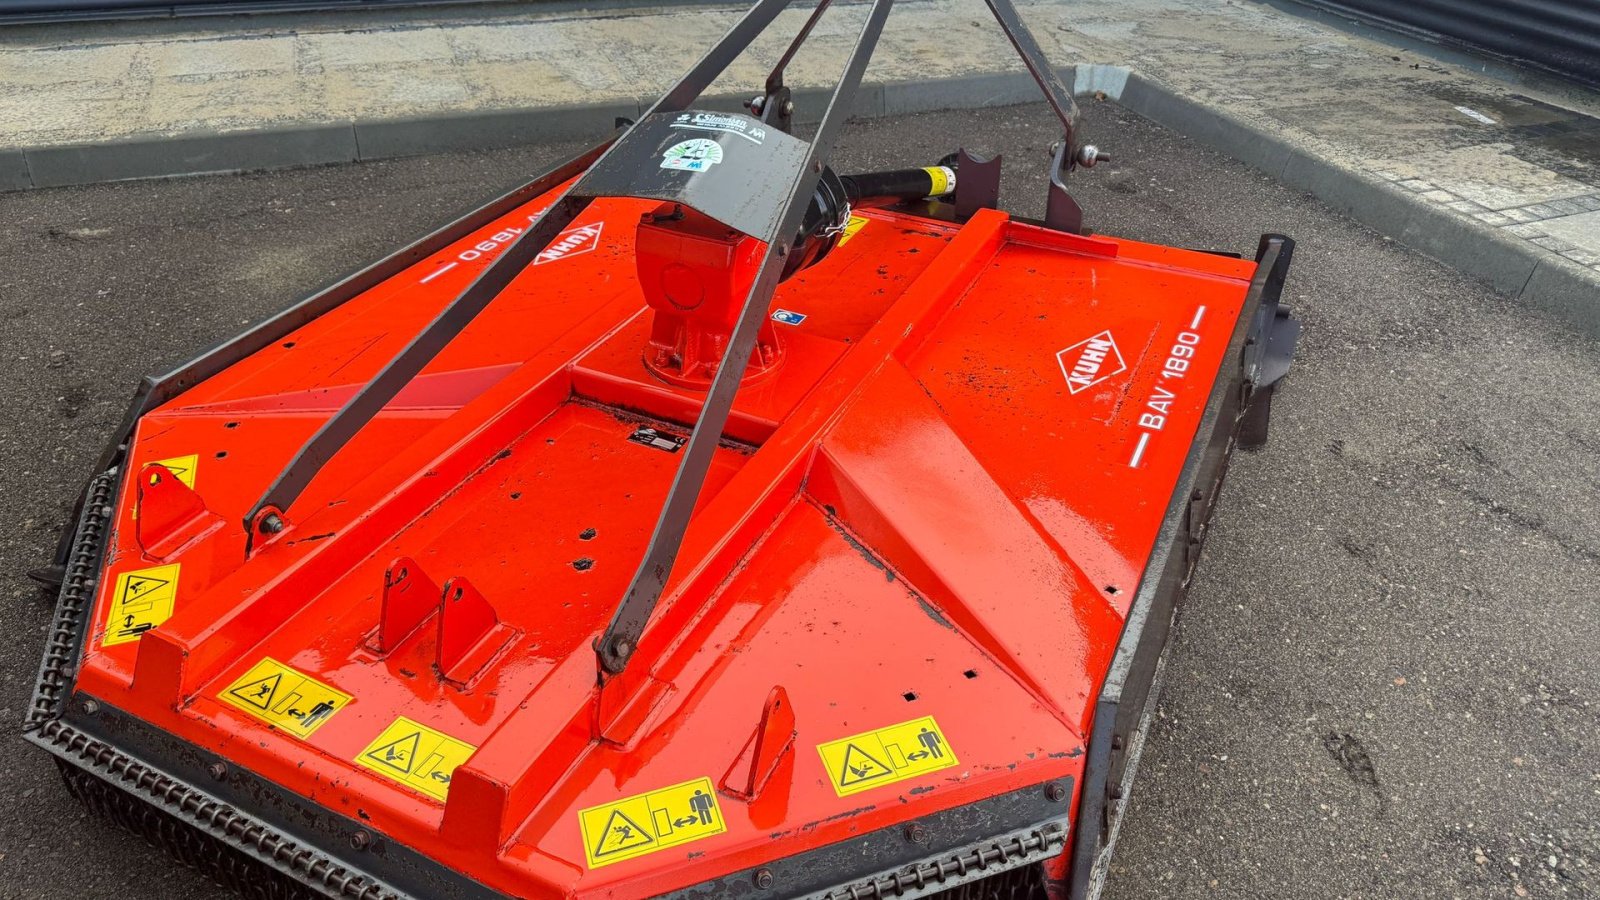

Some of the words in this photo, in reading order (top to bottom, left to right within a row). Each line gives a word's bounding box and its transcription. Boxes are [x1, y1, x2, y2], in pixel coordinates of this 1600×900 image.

[458, 227, 523, 261] 1890
[541, 227, 599, 261] KUHN
[1067, 337, 1113, 385] KUHN
[1138, 386, 1176, 430] BAV
[1161, 331, 1200, 379] 1890
